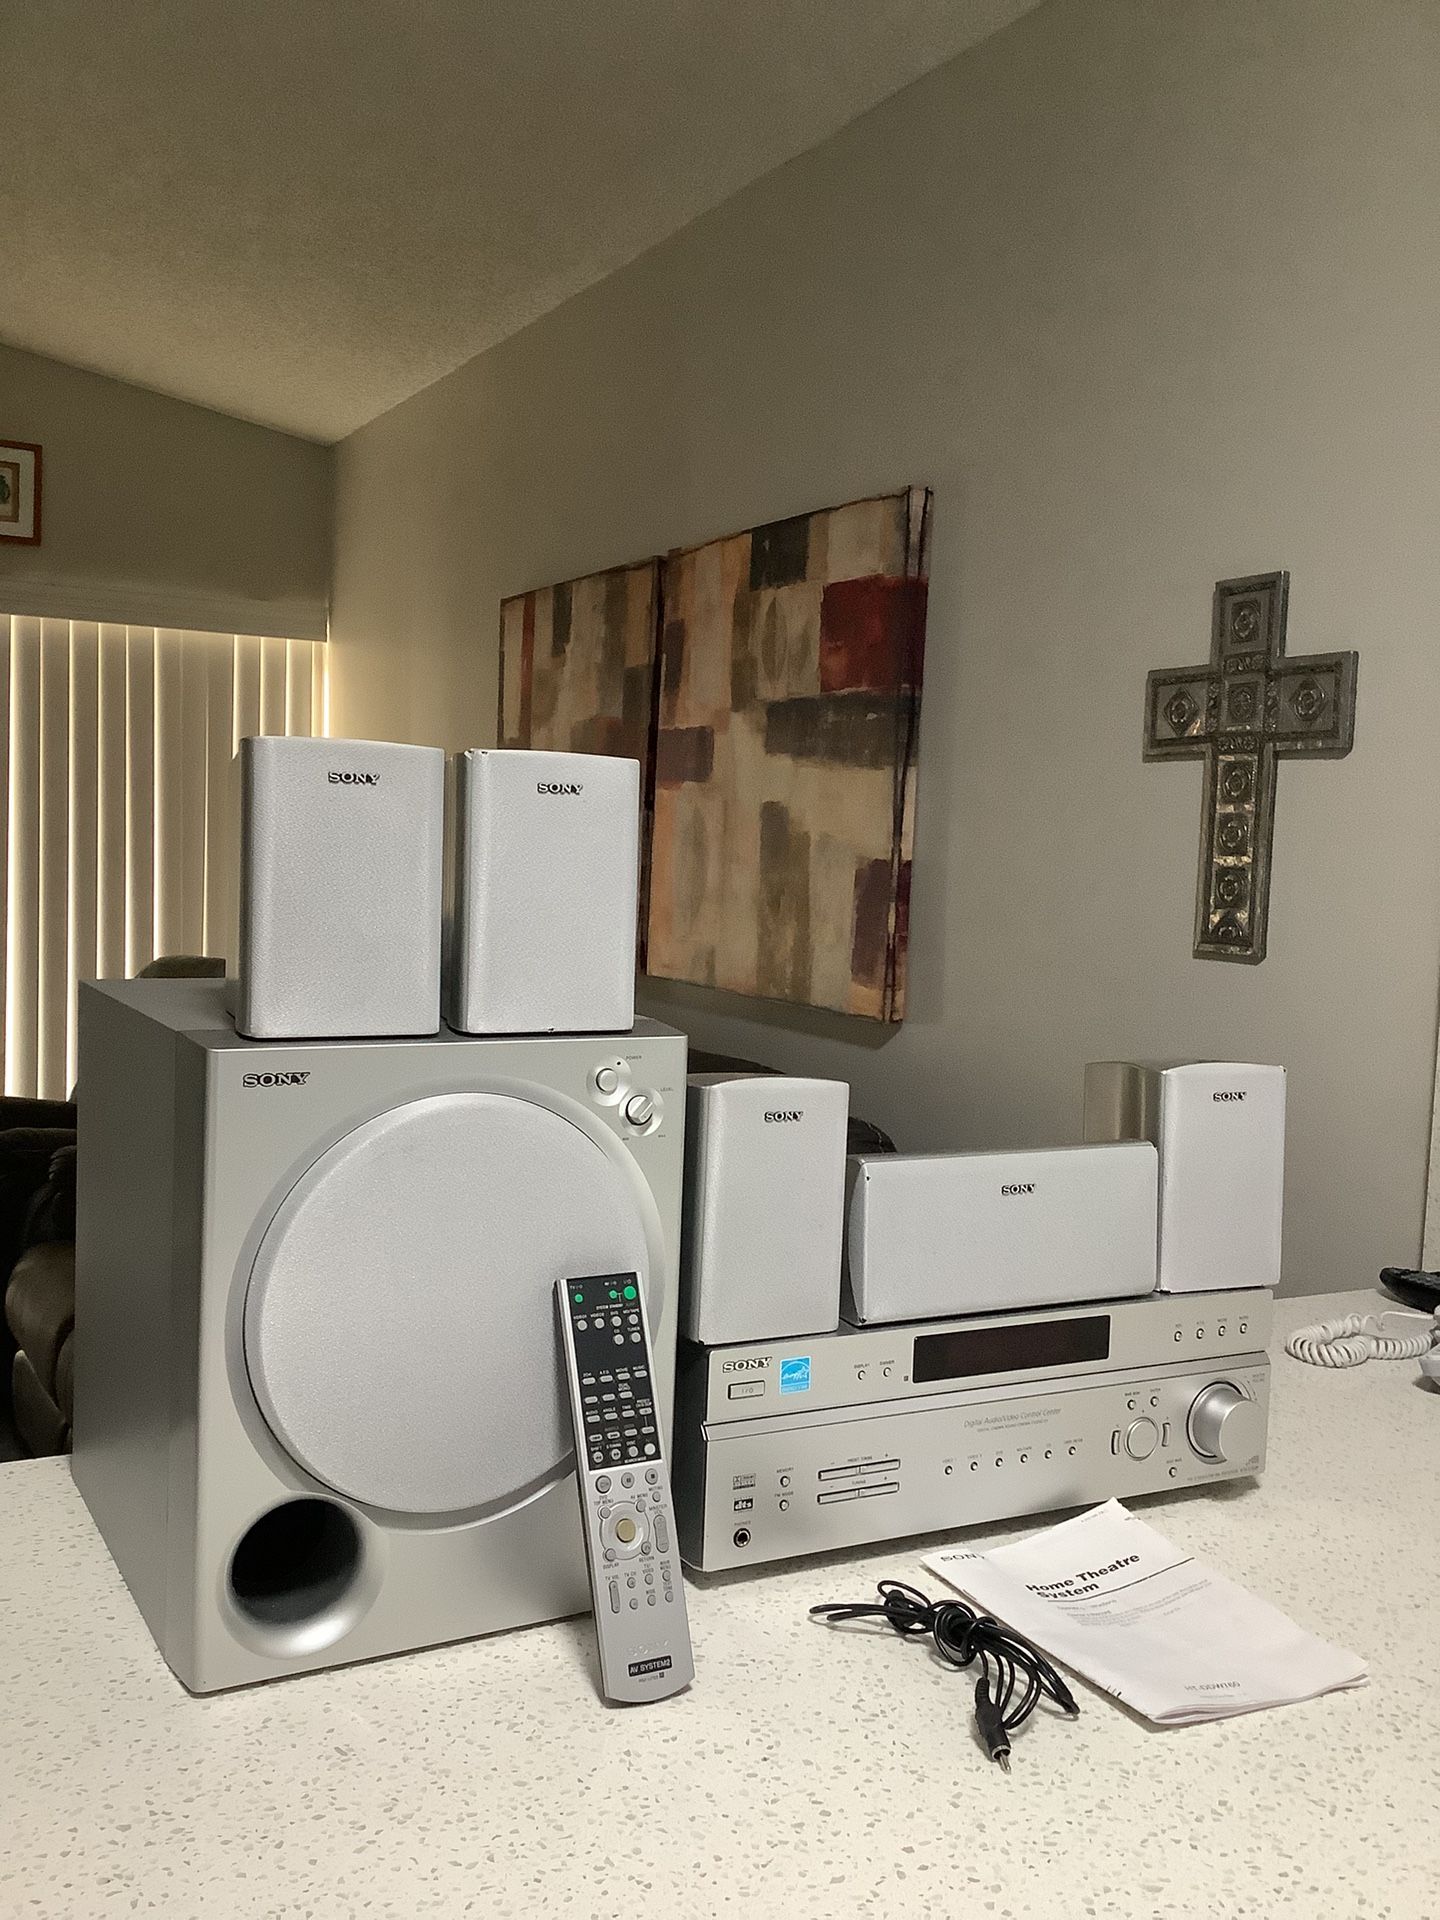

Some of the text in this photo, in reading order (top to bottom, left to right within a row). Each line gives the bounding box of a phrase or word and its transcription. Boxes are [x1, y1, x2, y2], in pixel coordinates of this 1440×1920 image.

[328, 771, 380, 786] SONY
[537, 782, 583, 795] SONY
[242, 1071, 310, 1088] SONY
[1213, 1091, 1247, 1102] SONY
[764, 1111, 803, 1123] SONY
[1001, 1183, 1037, 1196] SONY
[722, 1356, 773, 1373] SONY
[1020, 1411, 1042, 1420] Control
[1025, 1554, 1140, 1592] Home Theatre
[1036, 1582, 1100, 1600] System
[630, 1658, 671, 1674] AV SYSTEM2
